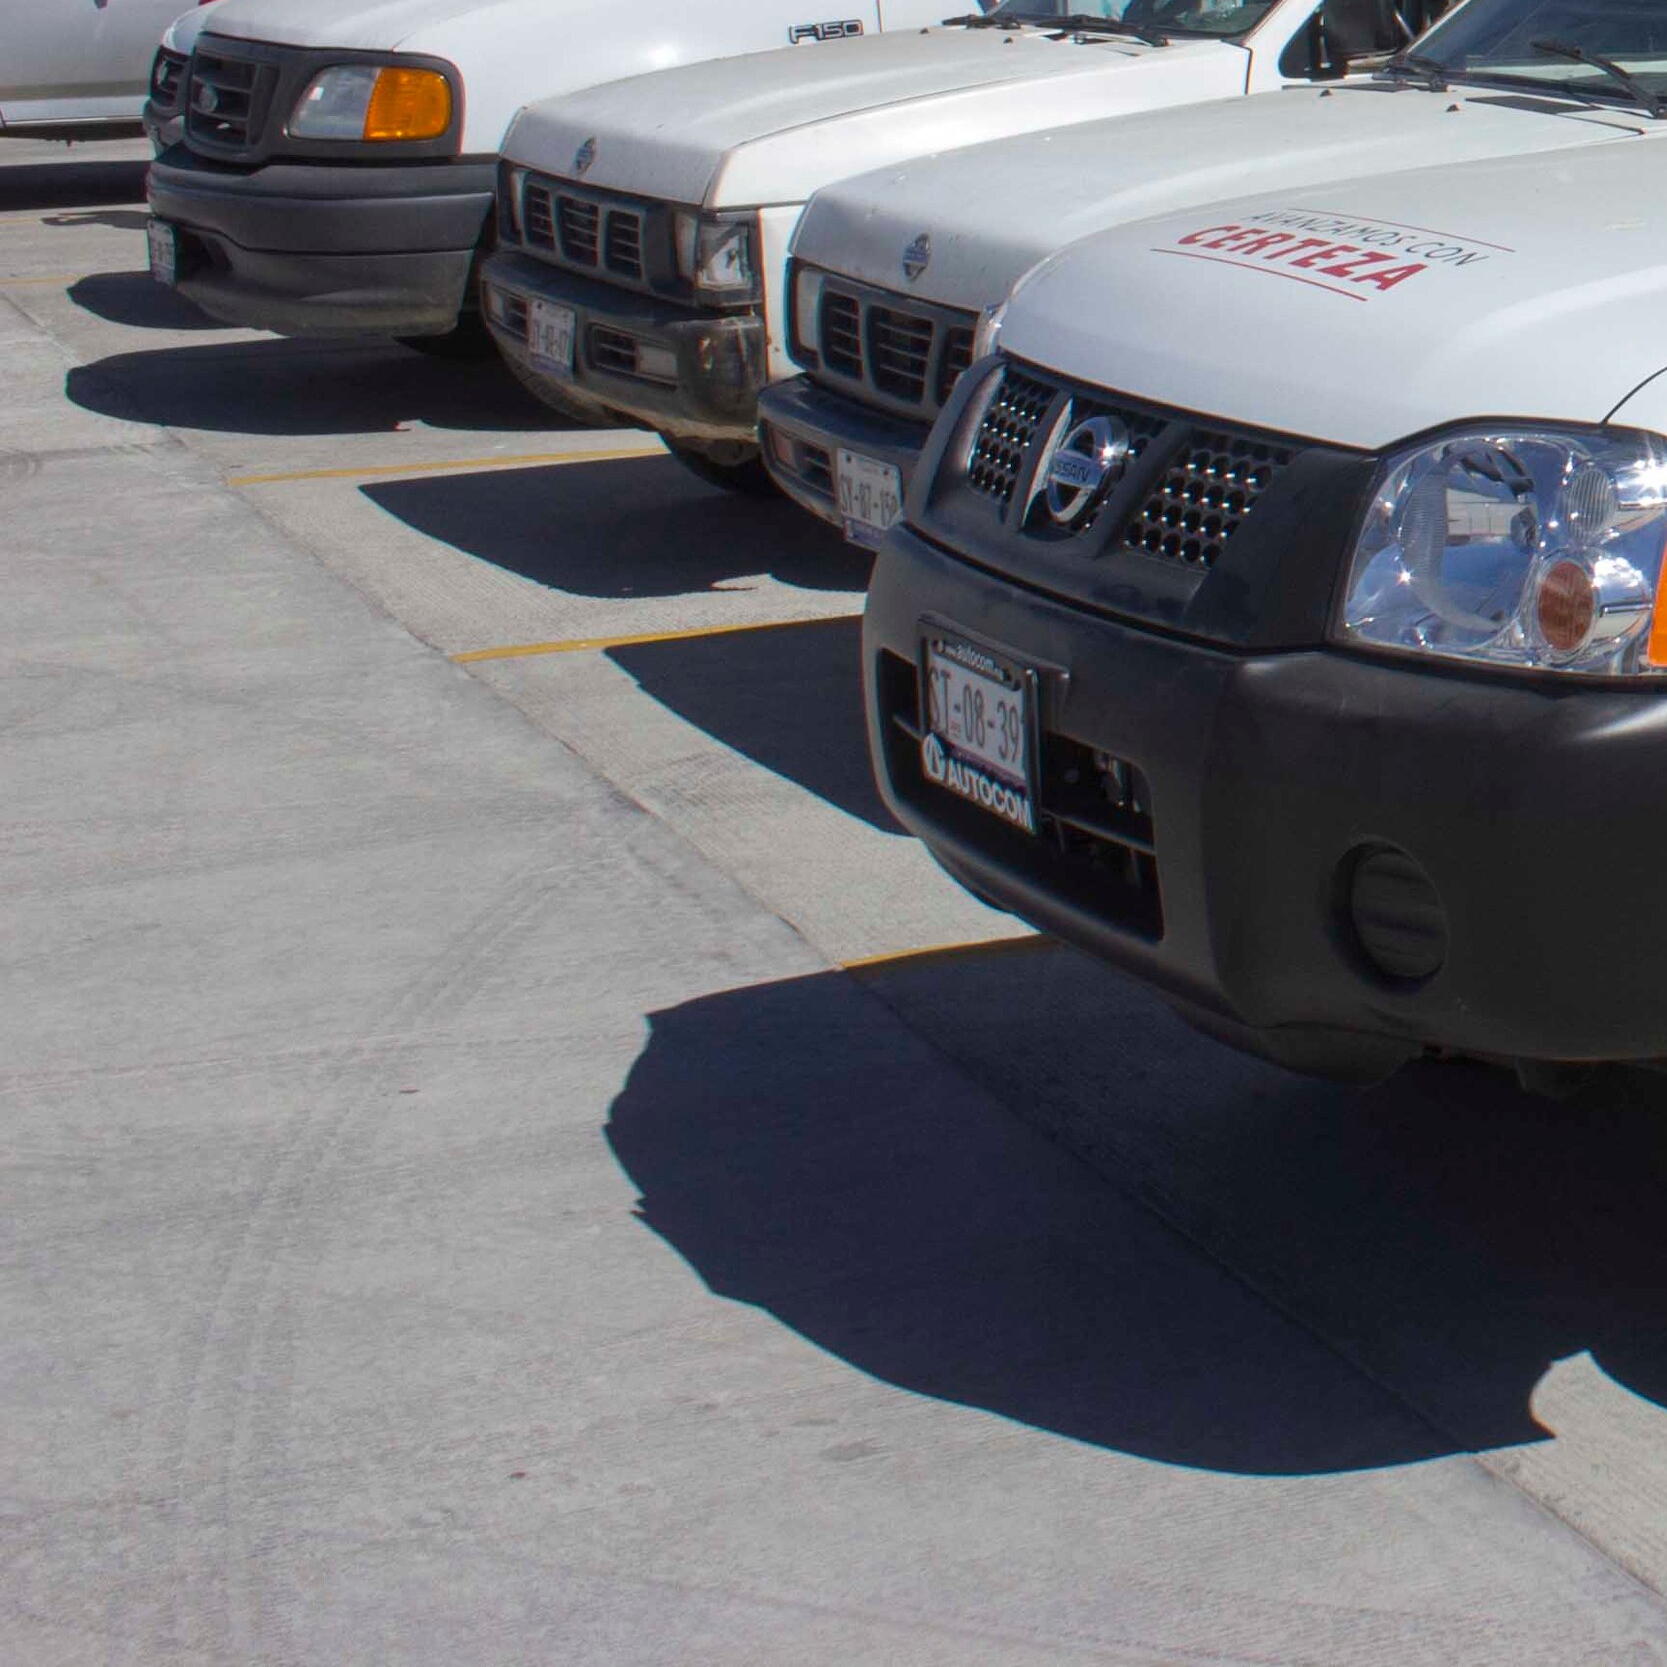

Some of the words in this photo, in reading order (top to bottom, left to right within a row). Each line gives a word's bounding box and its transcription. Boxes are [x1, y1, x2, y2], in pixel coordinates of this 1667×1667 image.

[1177, 225, 1429, 291] CERTEZA
[1245, 211, 1415, 247] AVANZAMOS
[1404, 241, 1489, 267] CON
[946, 758, 1034, 832] AUTOCOM
